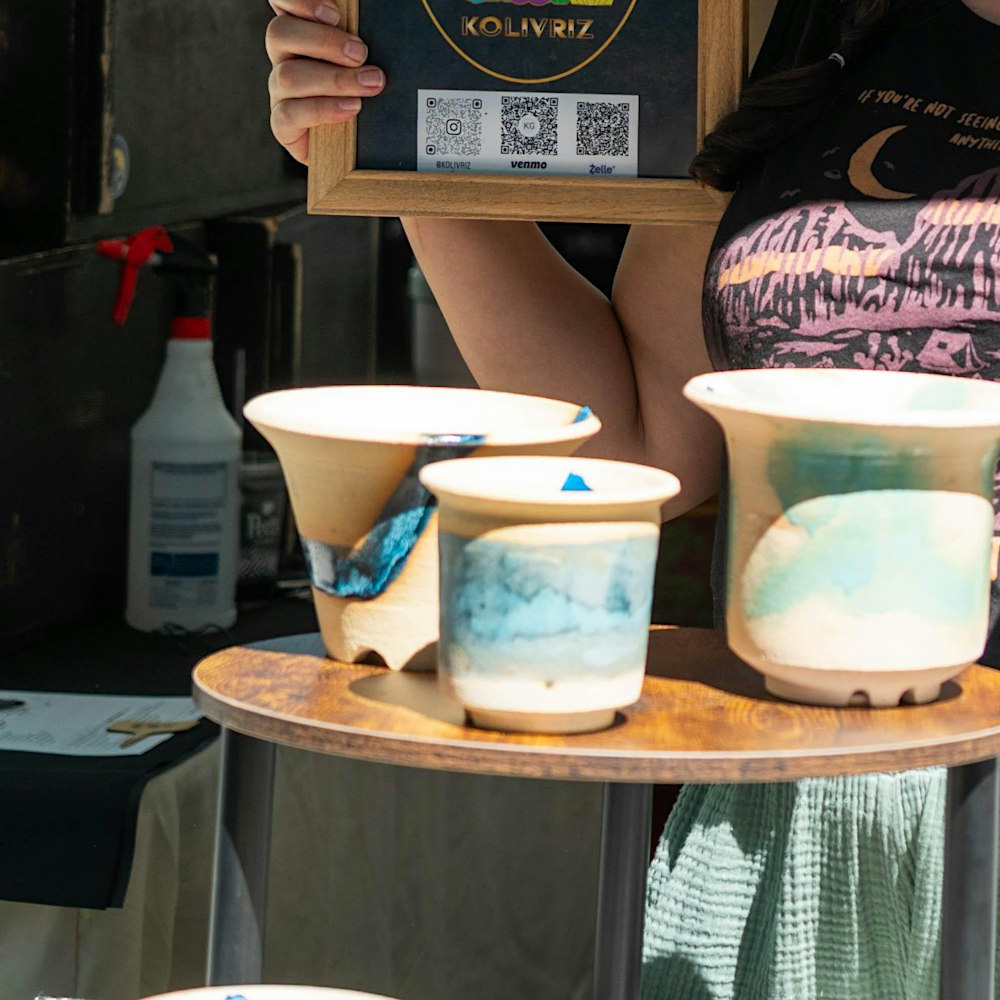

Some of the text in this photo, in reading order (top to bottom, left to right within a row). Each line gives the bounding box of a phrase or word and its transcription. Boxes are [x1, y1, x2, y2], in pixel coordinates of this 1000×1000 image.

[461, 16, 594, 39] KOLIVRIZ
[857, 89, 875, 104] IF
[876, 90, 923, 113] YOU'RE
[923, 101, 956, 120] NOT
[523, 121, 535, 130] KG
[436, 160, 471, 170] @KOLIVRIZ
[510, 160, 547, 169] venmo
